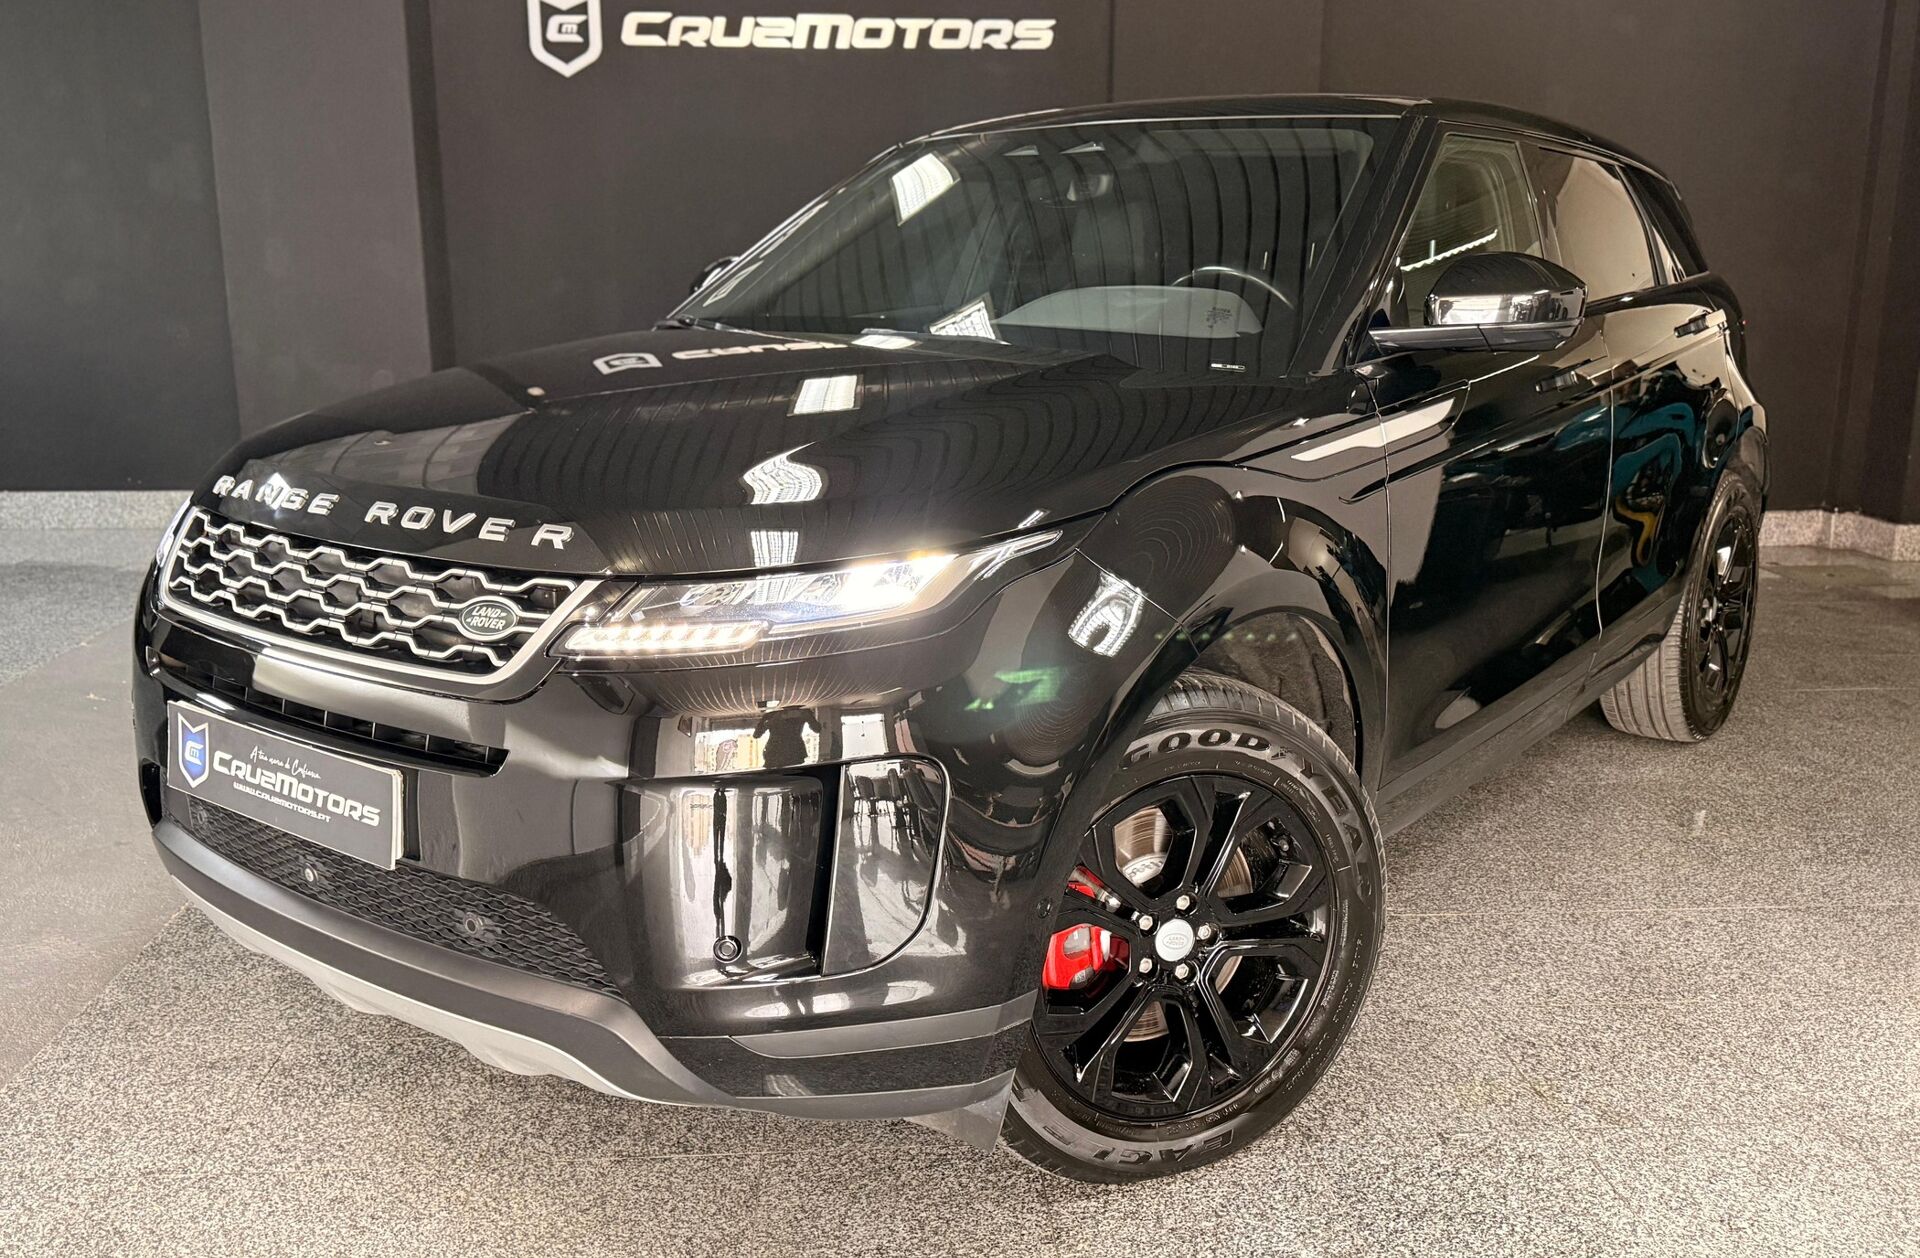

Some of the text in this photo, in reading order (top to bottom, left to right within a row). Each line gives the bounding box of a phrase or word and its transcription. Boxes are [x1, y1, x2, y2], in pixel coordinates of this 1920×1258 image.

[212, 475, 575, 550] RANGE ROVER
[471, 606, 502, 618] LAND
[470, 616, 506, 630] ROVER
